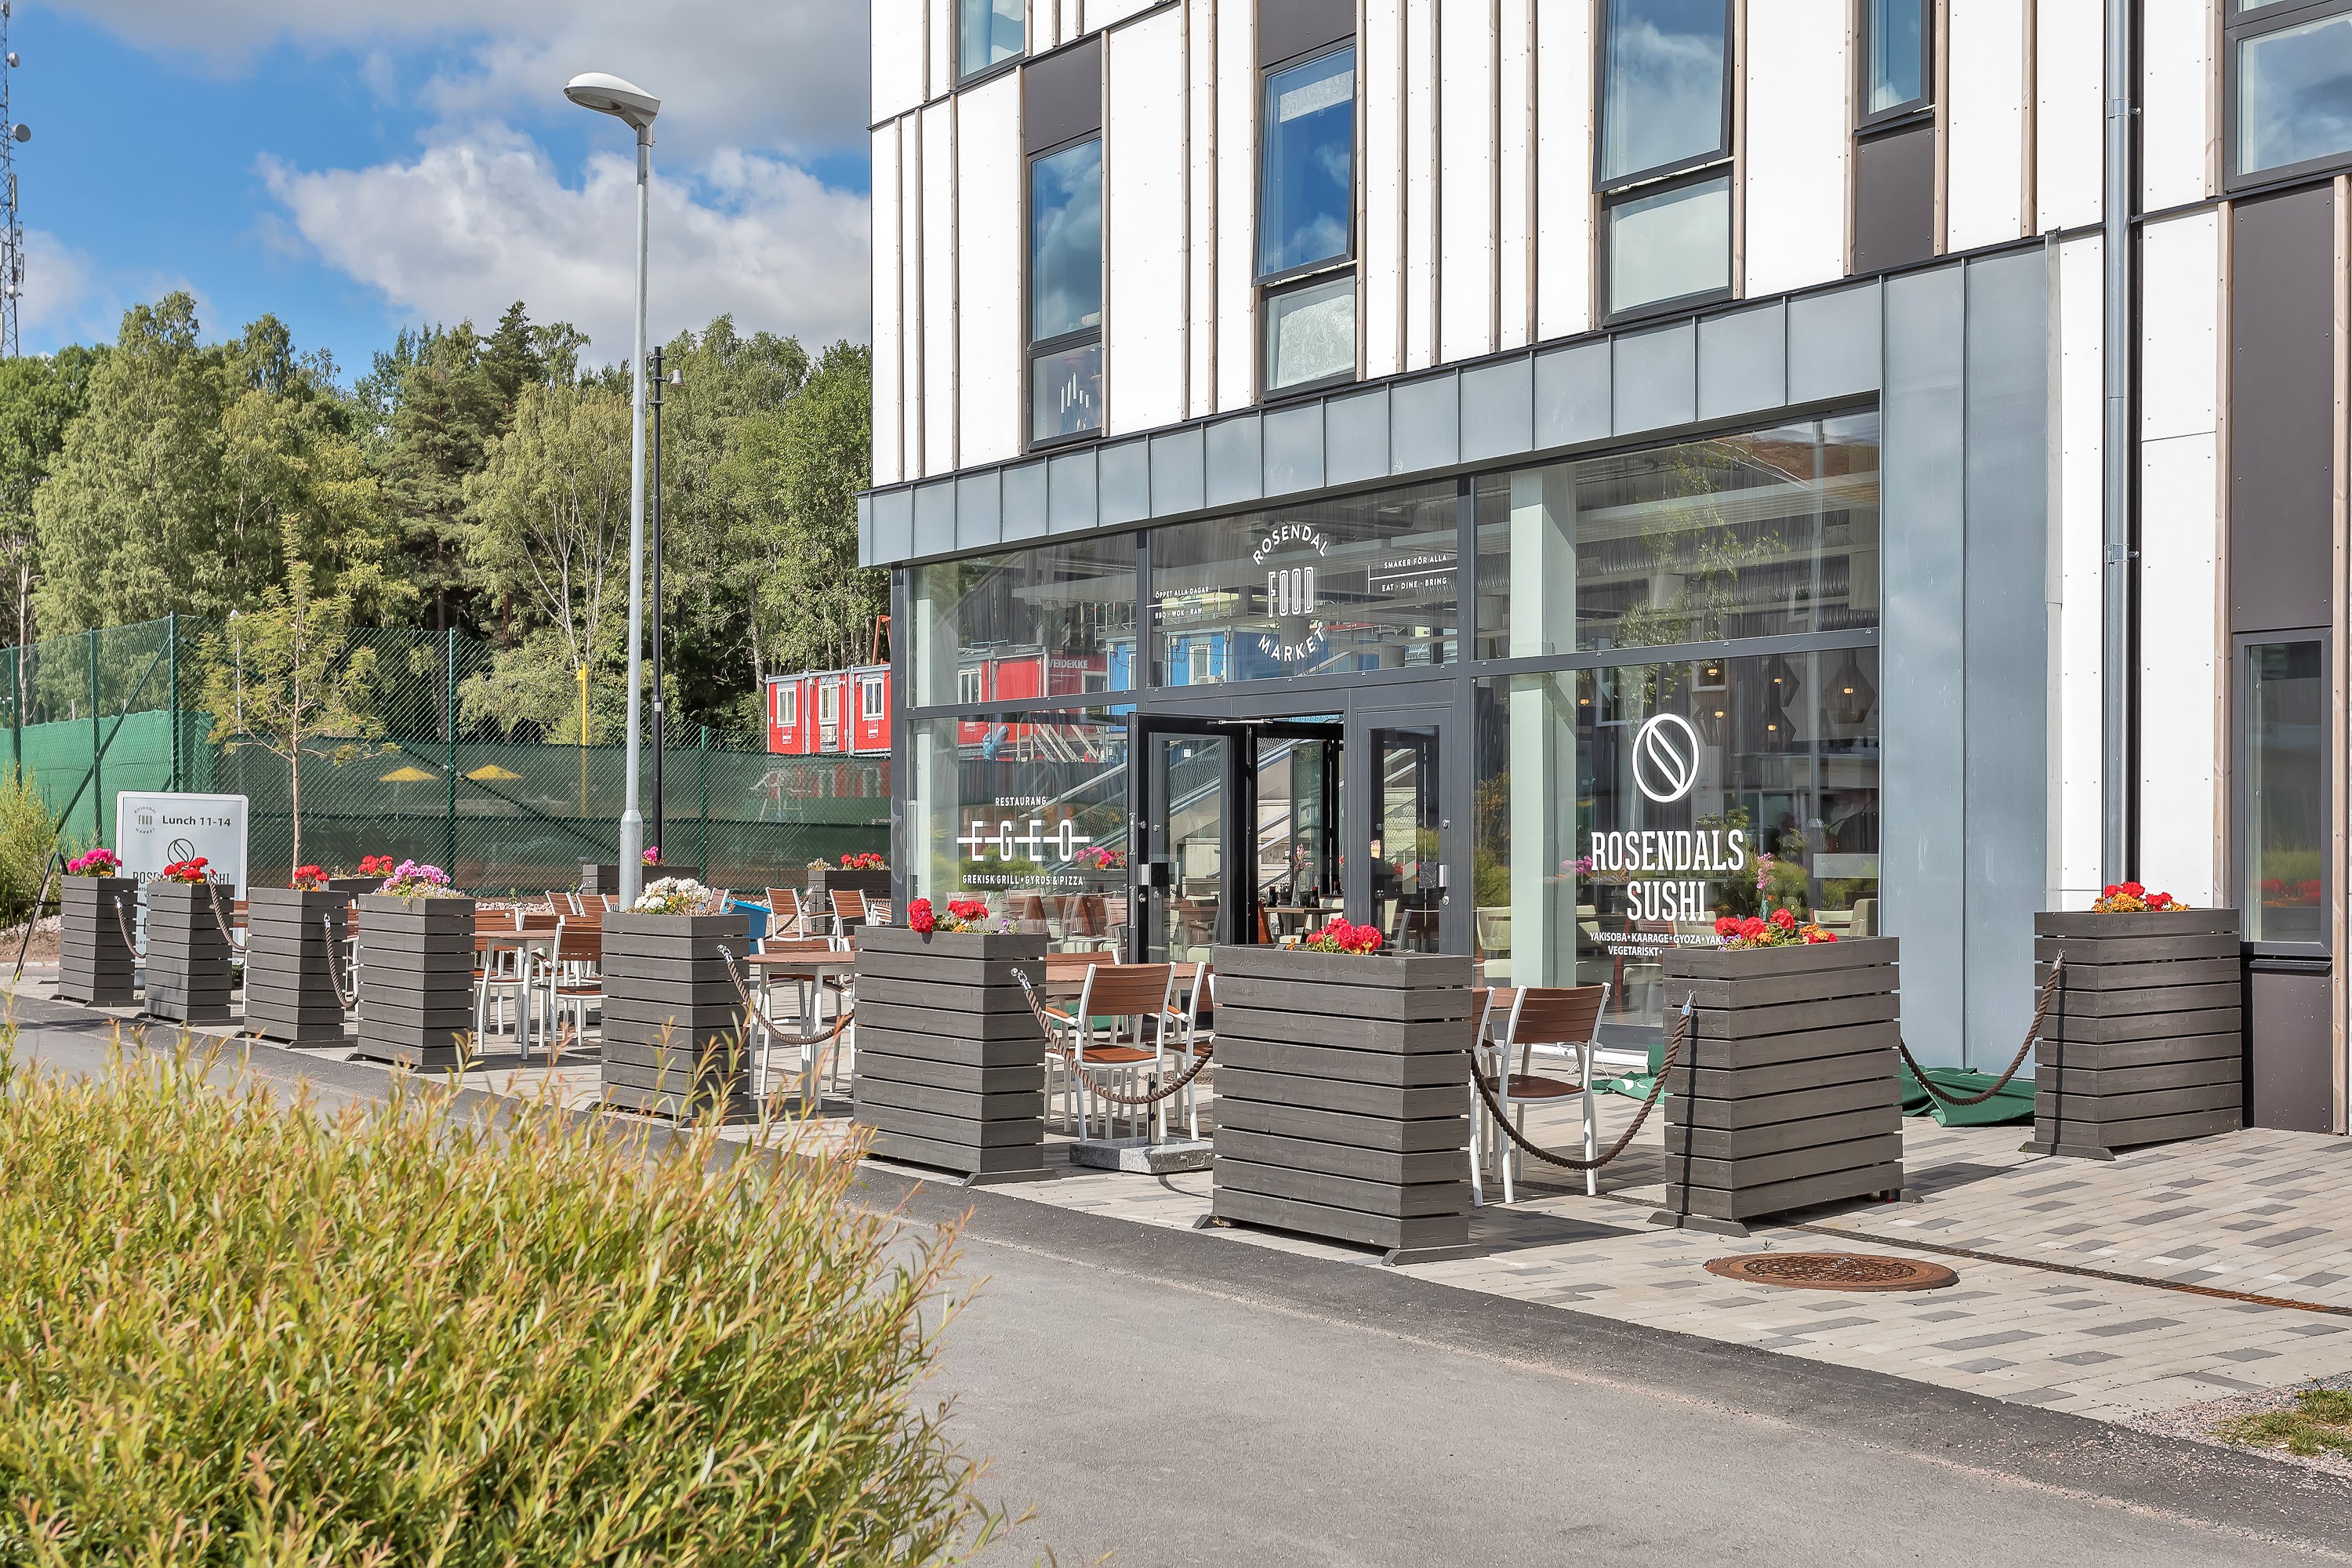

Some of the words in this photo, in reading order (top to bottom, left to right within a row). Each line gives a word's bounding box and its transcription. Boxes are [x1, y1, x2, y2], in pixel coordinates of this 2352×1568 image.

[1252, 524, 1328, 566] ROSENDAL
[1384, 558, 1411, 569] SMAKER
[1413, 555, 1428, 565] FÖR
[1429, 554, 1447, 563] ALLA
[1174, 588, 1188, 597] ALLA
[1189, 586, 1210, 594] DAGAR
[1382, 583, 1394, 592] EAT
[1401, 580, 1418, 590] DINE
[1425, 576, 1447, 586] BRING
[1268, 566, 1314, 618] FOOD
[1258, 626, 1325, 662] MARKET
[995, 796, 1047, 807] RESTAURANG
[162, 815, 196, 826] Lunch
[199, 817, 231, 827] 11-14
[970, 818, 1075, 862] EGEO
[1591, 829, 1744, 871] ROSENDALS
[205, 873, 230, 884] USHI
[962, 874, 996, 884] GREKISK
[996, 874, 1019, 885] GRILL
[1025, 875, 1051, 885] GYROS
[1052, 876, 1058, 885] &
[1059, 876, 1083, 886] PIZZA
[1627, 880, 1706, 922] SUSHI
[1589, 931, 1628, 942] YAKISOBA
[1632, 932, 1669, 943] KAARAGE
[1672, 934, 1701, 945] GYOZA
[1607, 945, 1660, 956] VEGETARISKT
